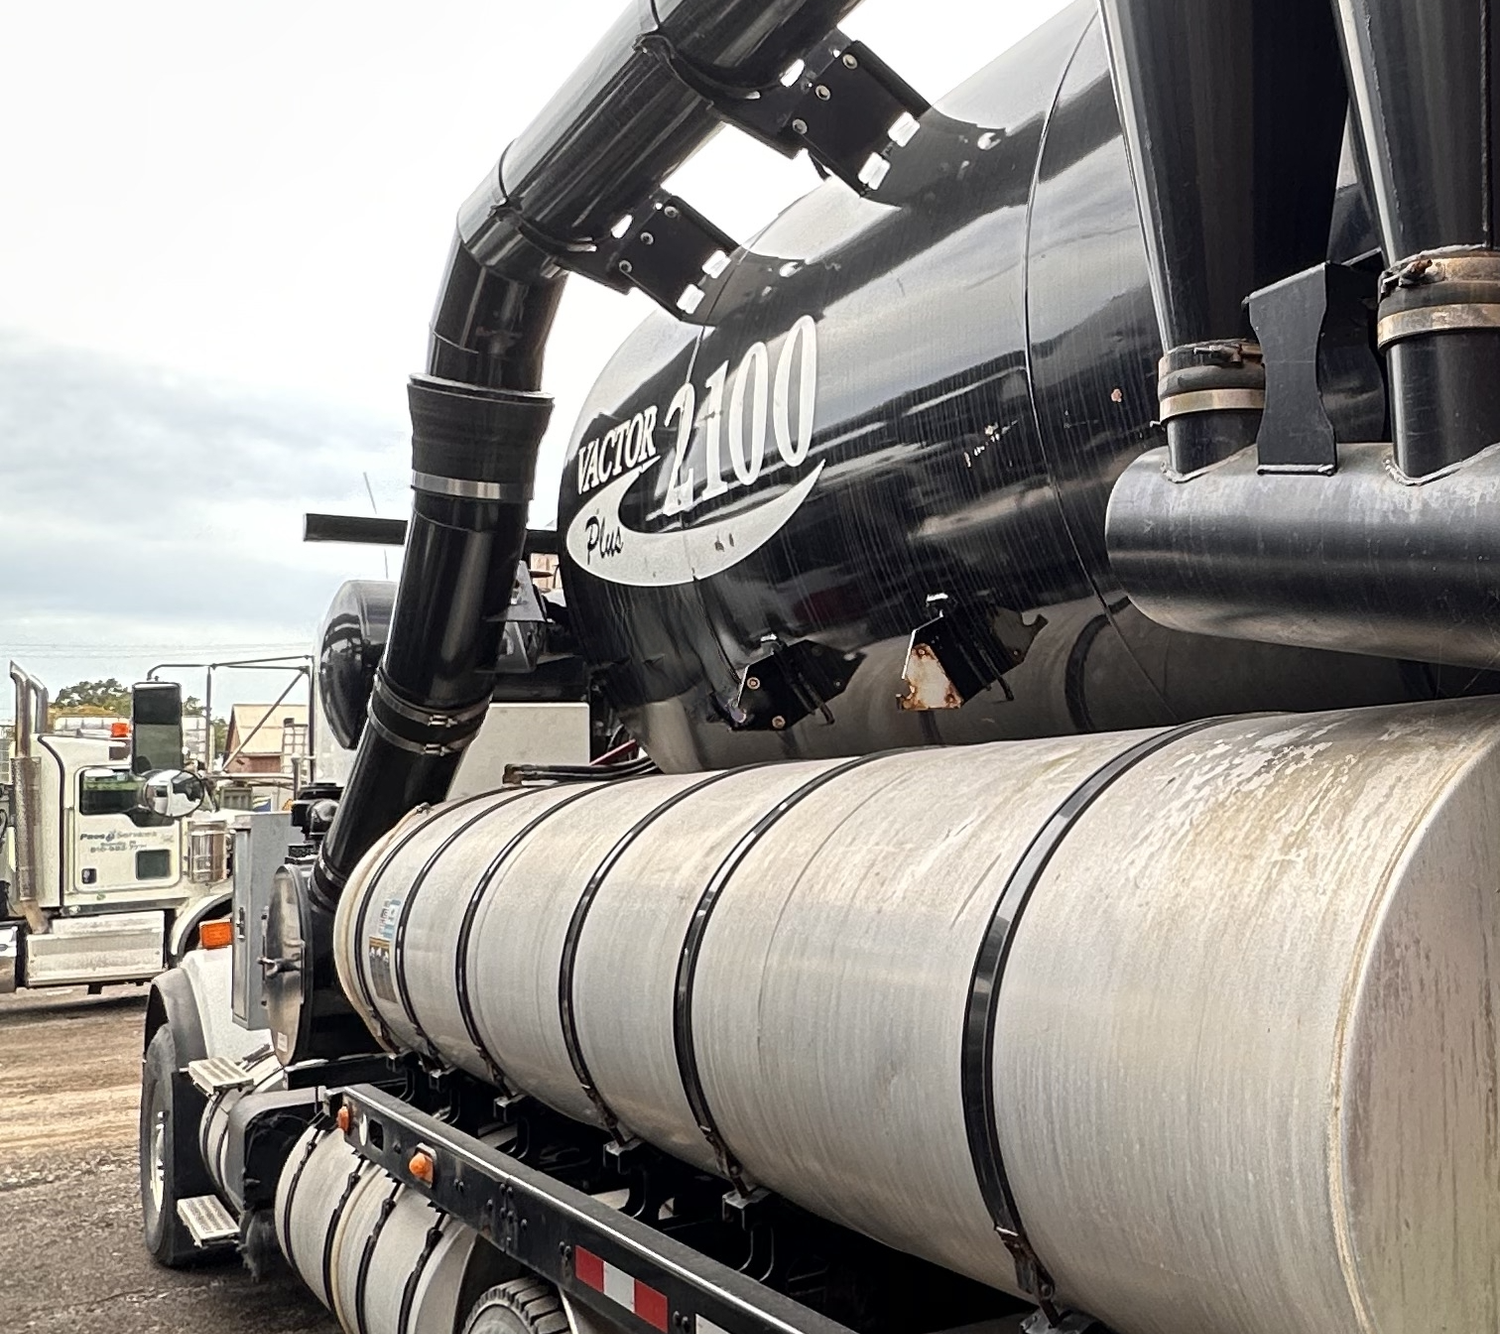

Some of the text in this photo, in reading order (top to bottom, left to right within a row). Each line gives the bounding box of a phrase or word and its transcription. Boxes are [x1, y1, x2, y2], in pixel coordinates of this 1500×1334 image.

[578, 405, 659, 495] VACTOR
[663, 314, 818, 517] 2100
[585, 514, 624, 565] Plus
